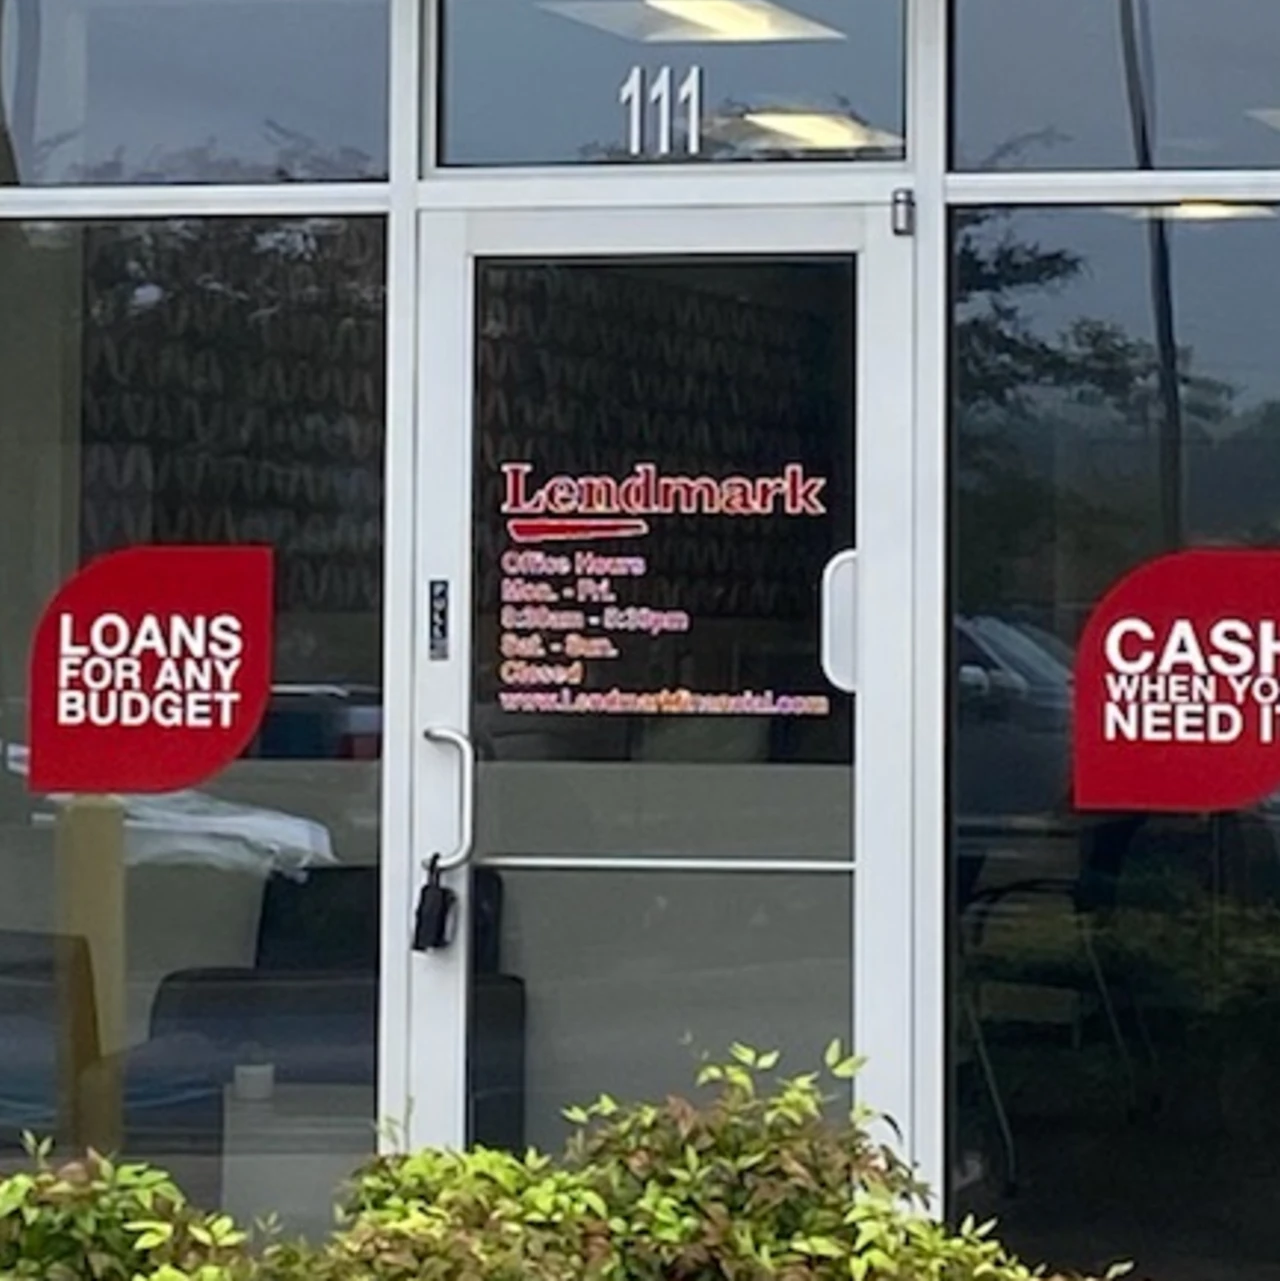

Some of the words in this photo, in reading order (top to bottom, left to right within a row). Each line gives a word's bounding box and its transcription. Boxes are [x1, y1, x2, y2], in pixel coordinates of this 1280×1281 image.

[620, 65, 702, 155] 111
[500, 462, 827, 515] Lendmark
[500, 550, 571, 576] Office
[574, 550, 647, 576] Hours
[59, 612, 243, 658] LOANS
[59, 657, 142, 691] FOR
[152, 657, 242, 692] ANY
[500, 660, 583, 685] Closed
[1105, 673, 1217, 703] WHEN
[57, 690, 242, 729] BUDGET
[1104, 702, 1244, 742] NEED
